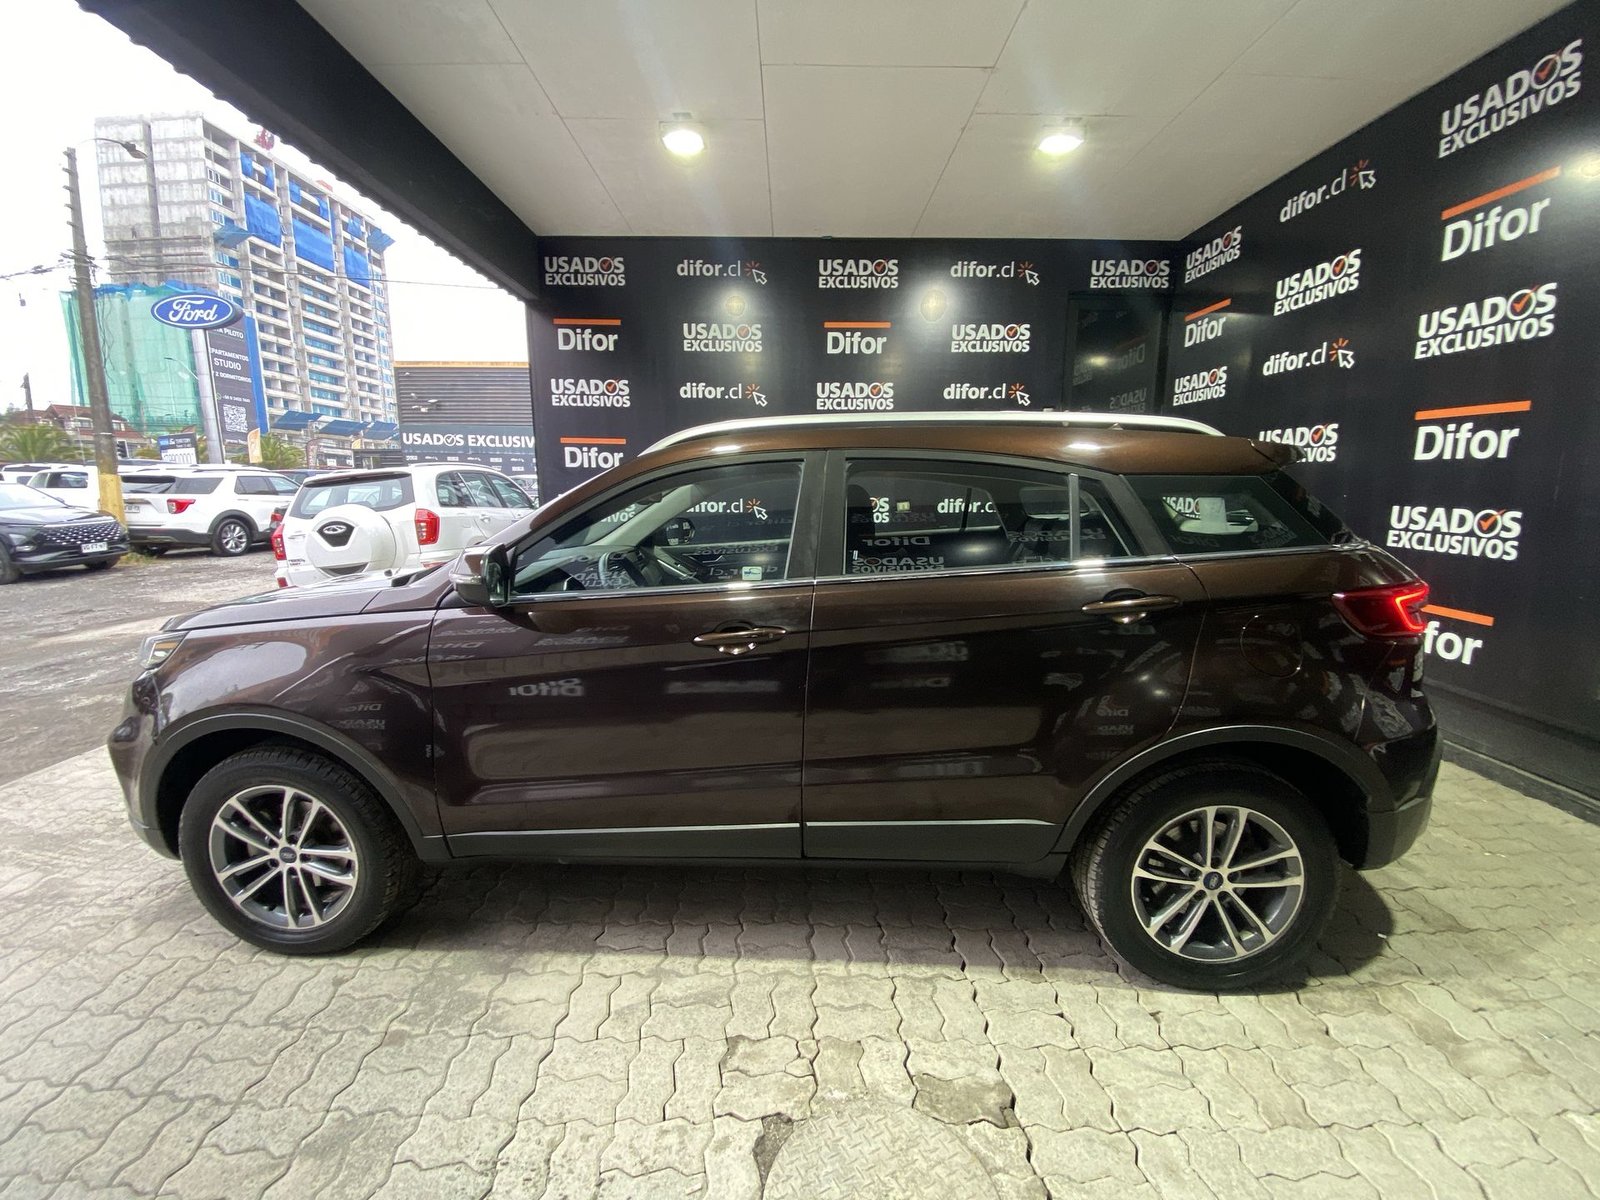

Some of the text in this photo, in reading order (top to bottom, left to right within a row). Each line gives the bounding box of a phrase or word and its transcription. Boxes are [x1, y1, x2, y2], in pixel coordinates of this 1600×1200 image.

[1441, 39, 1583, 136] USADOS
[1438, 71, 1581, 158] EXCLUSIVOS
[1279, 168, 1347, 222] difor.cl
[1441, 198, 1551, 262] Difor
[1186, 225, 1242, 270] USADOS
[544, 256, 625, 274] USADOS
[676, 259, 741, 277] difor.cl
[818, 259, 899, 277] USADOS
[950, 261, 1014, 278] difor.cl
[1091, 259, 1170, 277] USADOS
[1184, 244, 1241, 283] EXCLUSIVOS
[1276, 248, 1362, 300] USADOS
[545, 274, 626, 286] EXCLUSIVOS
[818, 276, 899, 289] EXCLUSIVOS
[1090, 276, 1170, 289] EXCLUSIVOS
[1273, 272, 1359, 316] EXCLUSIVOS
[168, 299, 218, 321] Ford
[1418, 282, 1557, 338] USADOS
[223, 327, 244, 339] PILOTO
[557, 328, 618, 351] Difor
[682, 323, 762, 341] USADOS
[951, 323, 1030, 341] USADOS
[1184, 315, 1226, 347] Difor
[1414, 314, 1555, 360] EXCLUSIVOS
[683, 340, 763, 352] EXCLUSIVOS
[826, 331, 887, 354] Difor
[951, 340, 1030, 353] EXCLUSIVOS
[213, 357, 242, 371] STUDIO
[1263, 342, 1327, 377] difor.cl
[551, 378, 629, 395] USADOS
[1174, 365, 1227, 393] USADOS
[551, 394, 631, 407] EXCLUSIVOS
[679, 382, 742, 399] difor.cl
[816, 382, 894, 399] USADOS
[943, 383, 1006, 400] difor.cl
[1173, 383, 1226, 406] EXCLUSIVOS
[816, 398, 894, 411] EXCLUSIVOS
[402, 433, 535, 448] USADOS EXCLUSIV
[1259, 423, 1339, 447] USADOS
[1413, 421, 1520, 461] Difor
[564, 446, 624, 468] Difor
[1389, 505, 1523, 540] USADOS
[1386, 530, 1519, 560] EXCLUSIVOS
[1423, 620, 1483, 665] for
